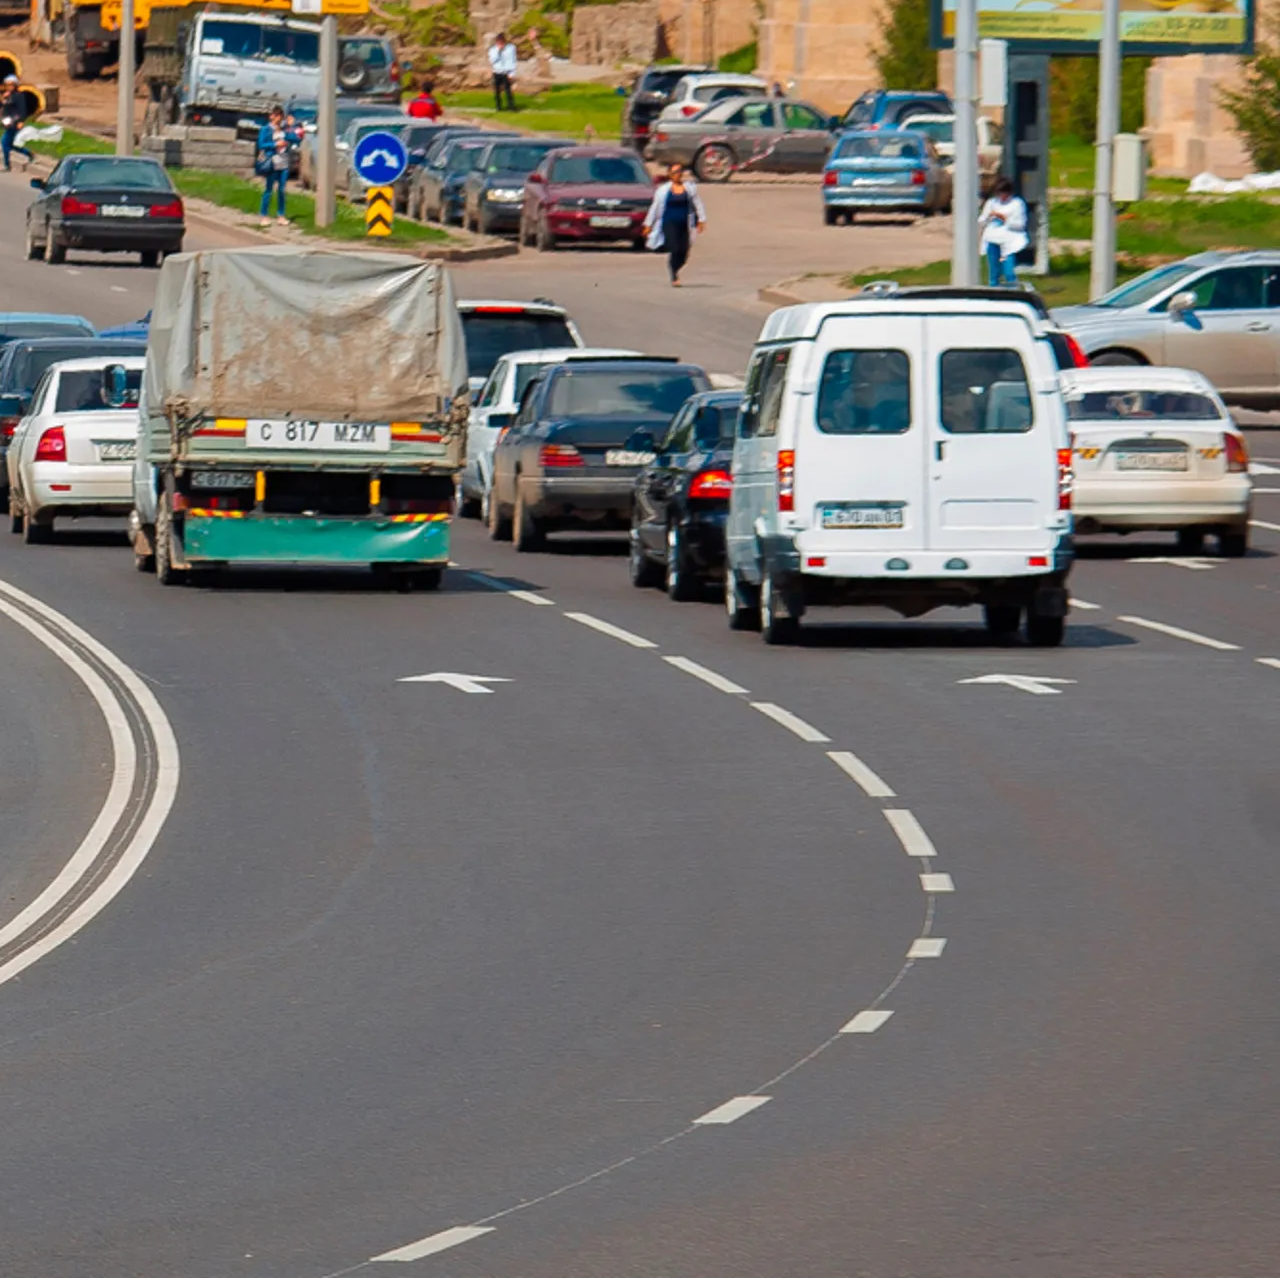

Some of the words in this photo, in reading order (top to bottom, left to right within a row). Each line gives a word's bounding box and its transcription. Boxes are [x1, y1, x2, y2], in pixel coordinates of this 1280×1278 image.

[260, 423, 272, 441] C
[285, 421, 319, 442] 817
[334, 424, 376, 443] MZM
